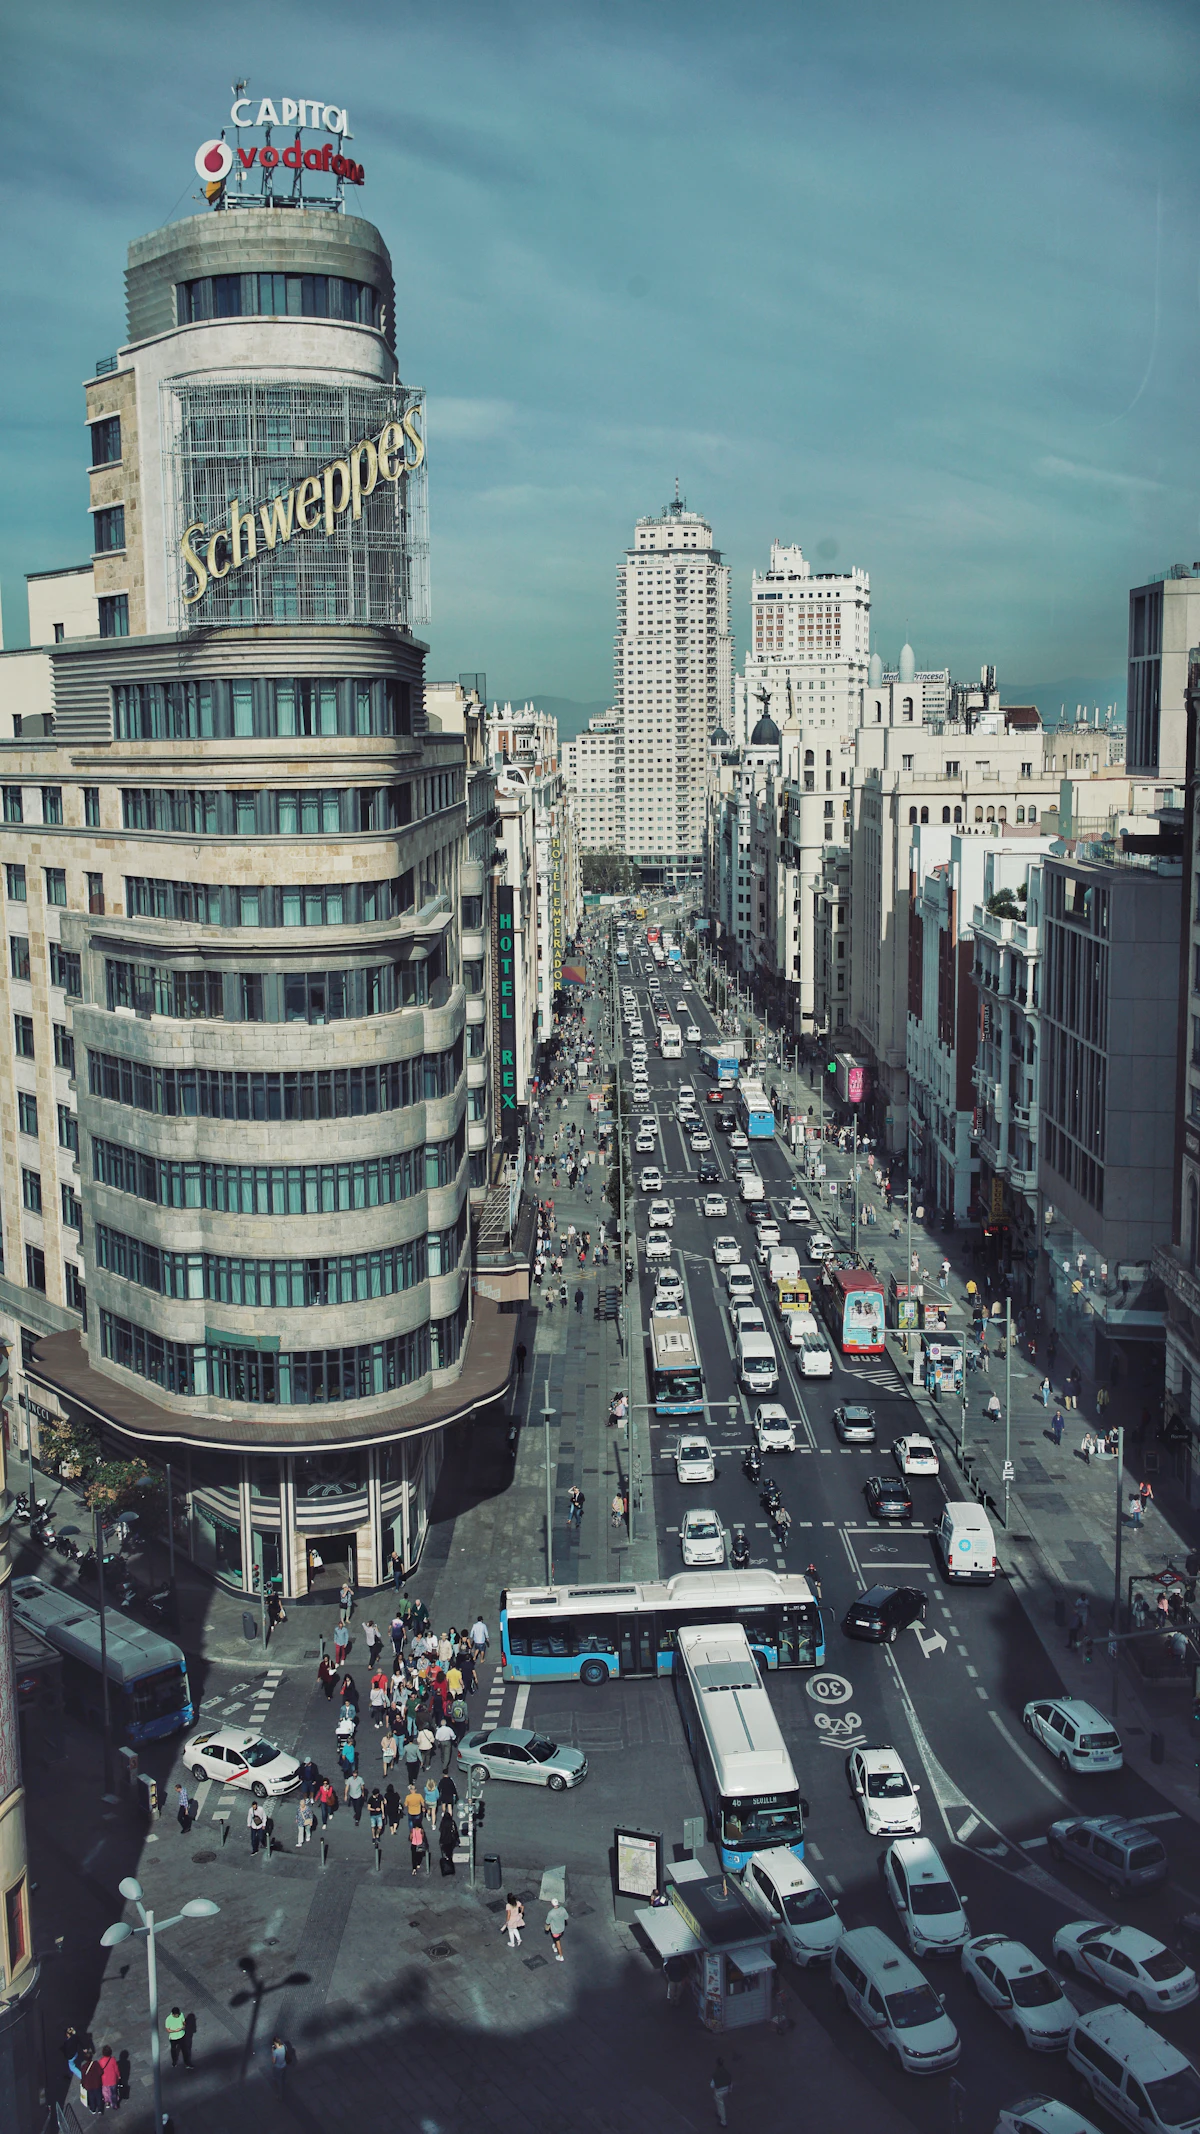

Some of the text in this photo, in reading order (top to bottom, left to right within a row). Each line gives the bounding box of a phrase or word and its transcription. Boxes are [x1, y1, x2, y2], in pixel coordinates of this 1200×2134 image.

[231, 97, 354, 140] CAPITOL
[237, 139, 365, 186] vodafone
[180, 403, 425, 606] Schweppes
[552, 839, 563, 990] HOTEL EMPERADOR
[500, 913, 516, 1110] HOTEL REX
[816, 1681, 843, 1697] 30
